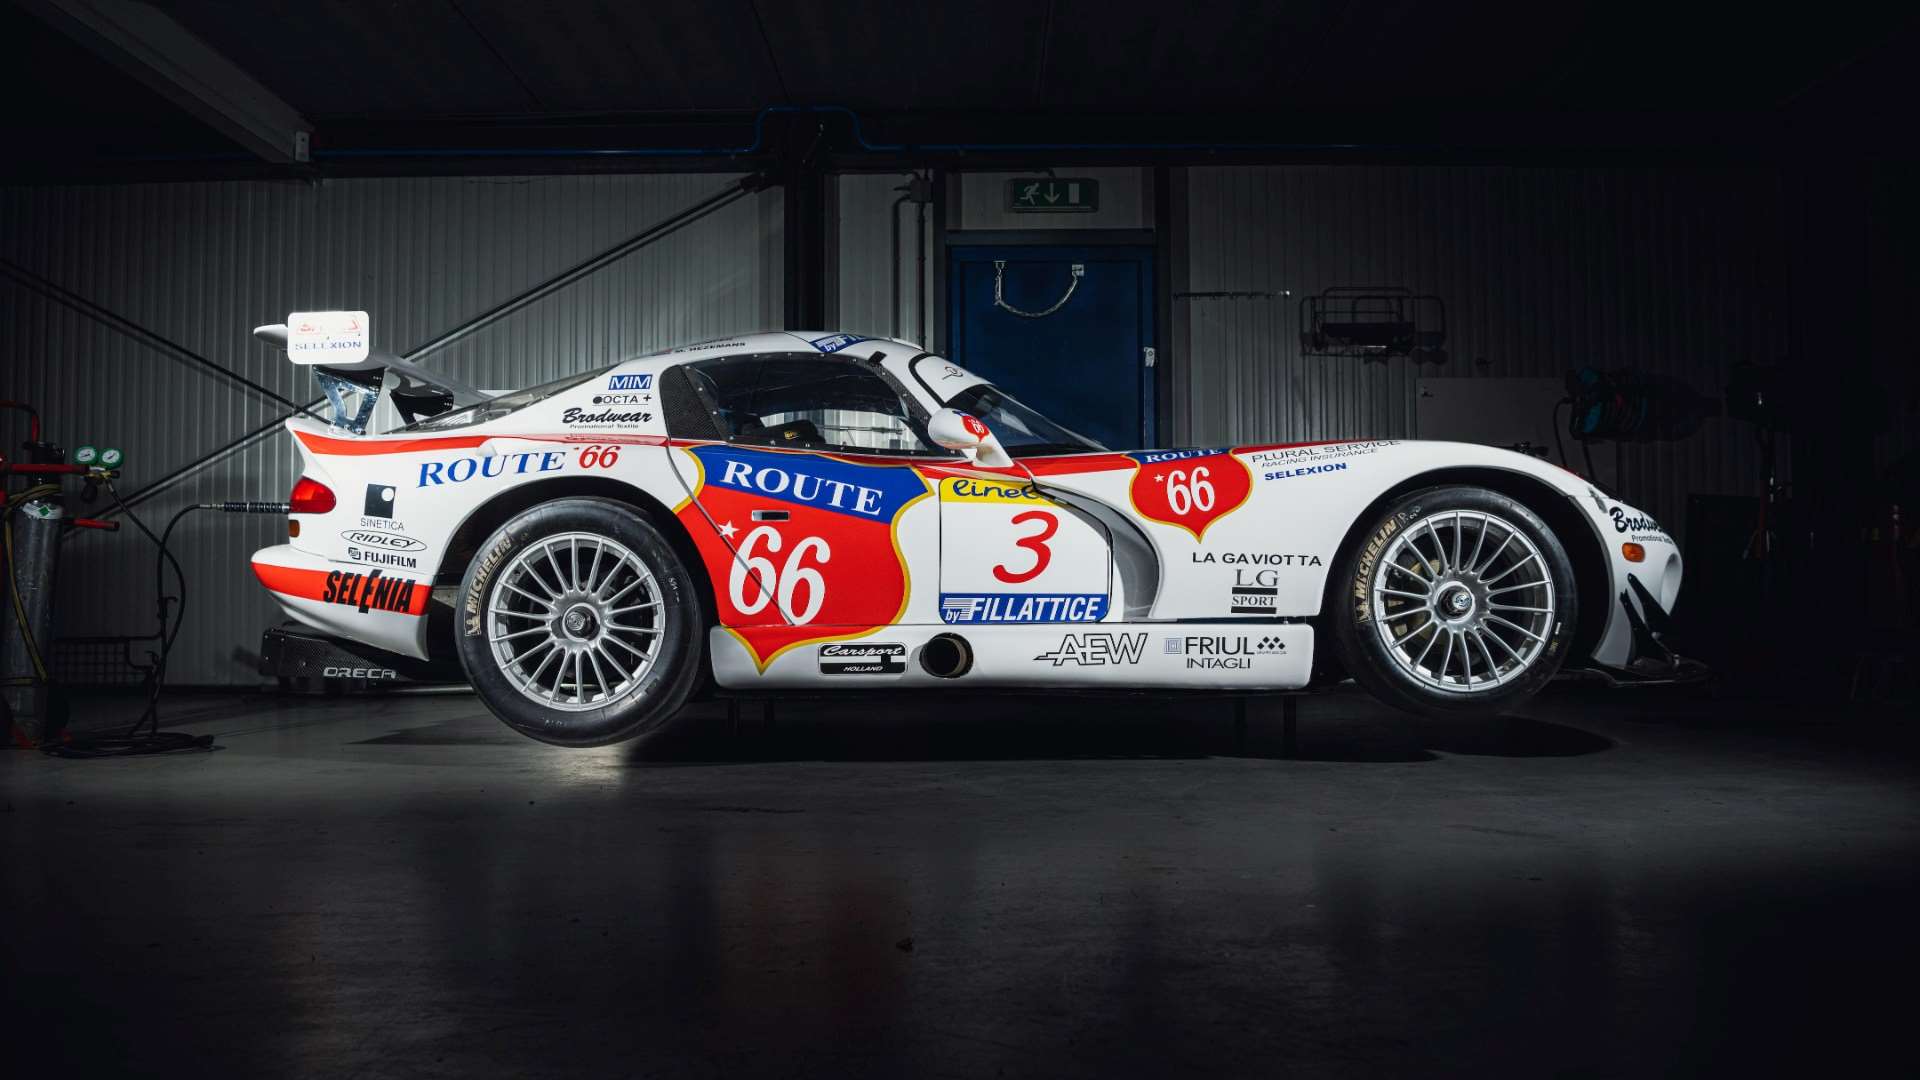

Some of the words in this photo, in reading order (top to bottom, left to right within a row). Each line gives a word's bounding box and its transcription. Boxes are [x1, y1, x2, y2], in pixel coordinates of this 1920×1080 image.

[610, 375, 651, 389] MIM
[562, 407, 653, 424] Brodwear
[1145, 448, 1222, 463] ROUTE
[1252, 447, 1321, 463] PLURAL
[1323, 440, 1401, 453] SERVICE
[1261, 456, 1308, 468] RACING
[1310, 449, 1378, 462] INSURANCE
[416, 451, 567, 489] ROUTE
[579, 445, 621, 469] 66
[1264, 462, 1348, 481] SELEXION
[720, 459, 883, 516] ROUTE
[1166, 466, 1216, 516] 66
[360, 517, 405, 532] SINETICA
[350, 532, 417, 549] RIDLEY
[992, 510, 1059, 584] 3
[364, 550, 417, 569] FUJIFILM
[1192, 552, 1217, 564] LA
[1221, 552, 1323, 567] GAVIOTTA
[1354, 519, 1398, 600] MICHELIN
[466, 536, 513, 615] MICHELIN
[729, 525, 831, 626] 66
[1234, 568, 1280, 588] LG
[944, 608, 961, 624] by
[966, 597, 1102, 622] FILLATTICE
[1231, 595, 1277, 608] SPORT
[823, 643, 904, 658] Carsport
[1048, 632, 1149, 666] AEW
[1185, 636, 1256, 656] FRIUL
[323, 666, 397, 679] ORECA
[843, 664, 884, 673] HOLLAND
[1186, 657, 1252, 670] INTAGLI
